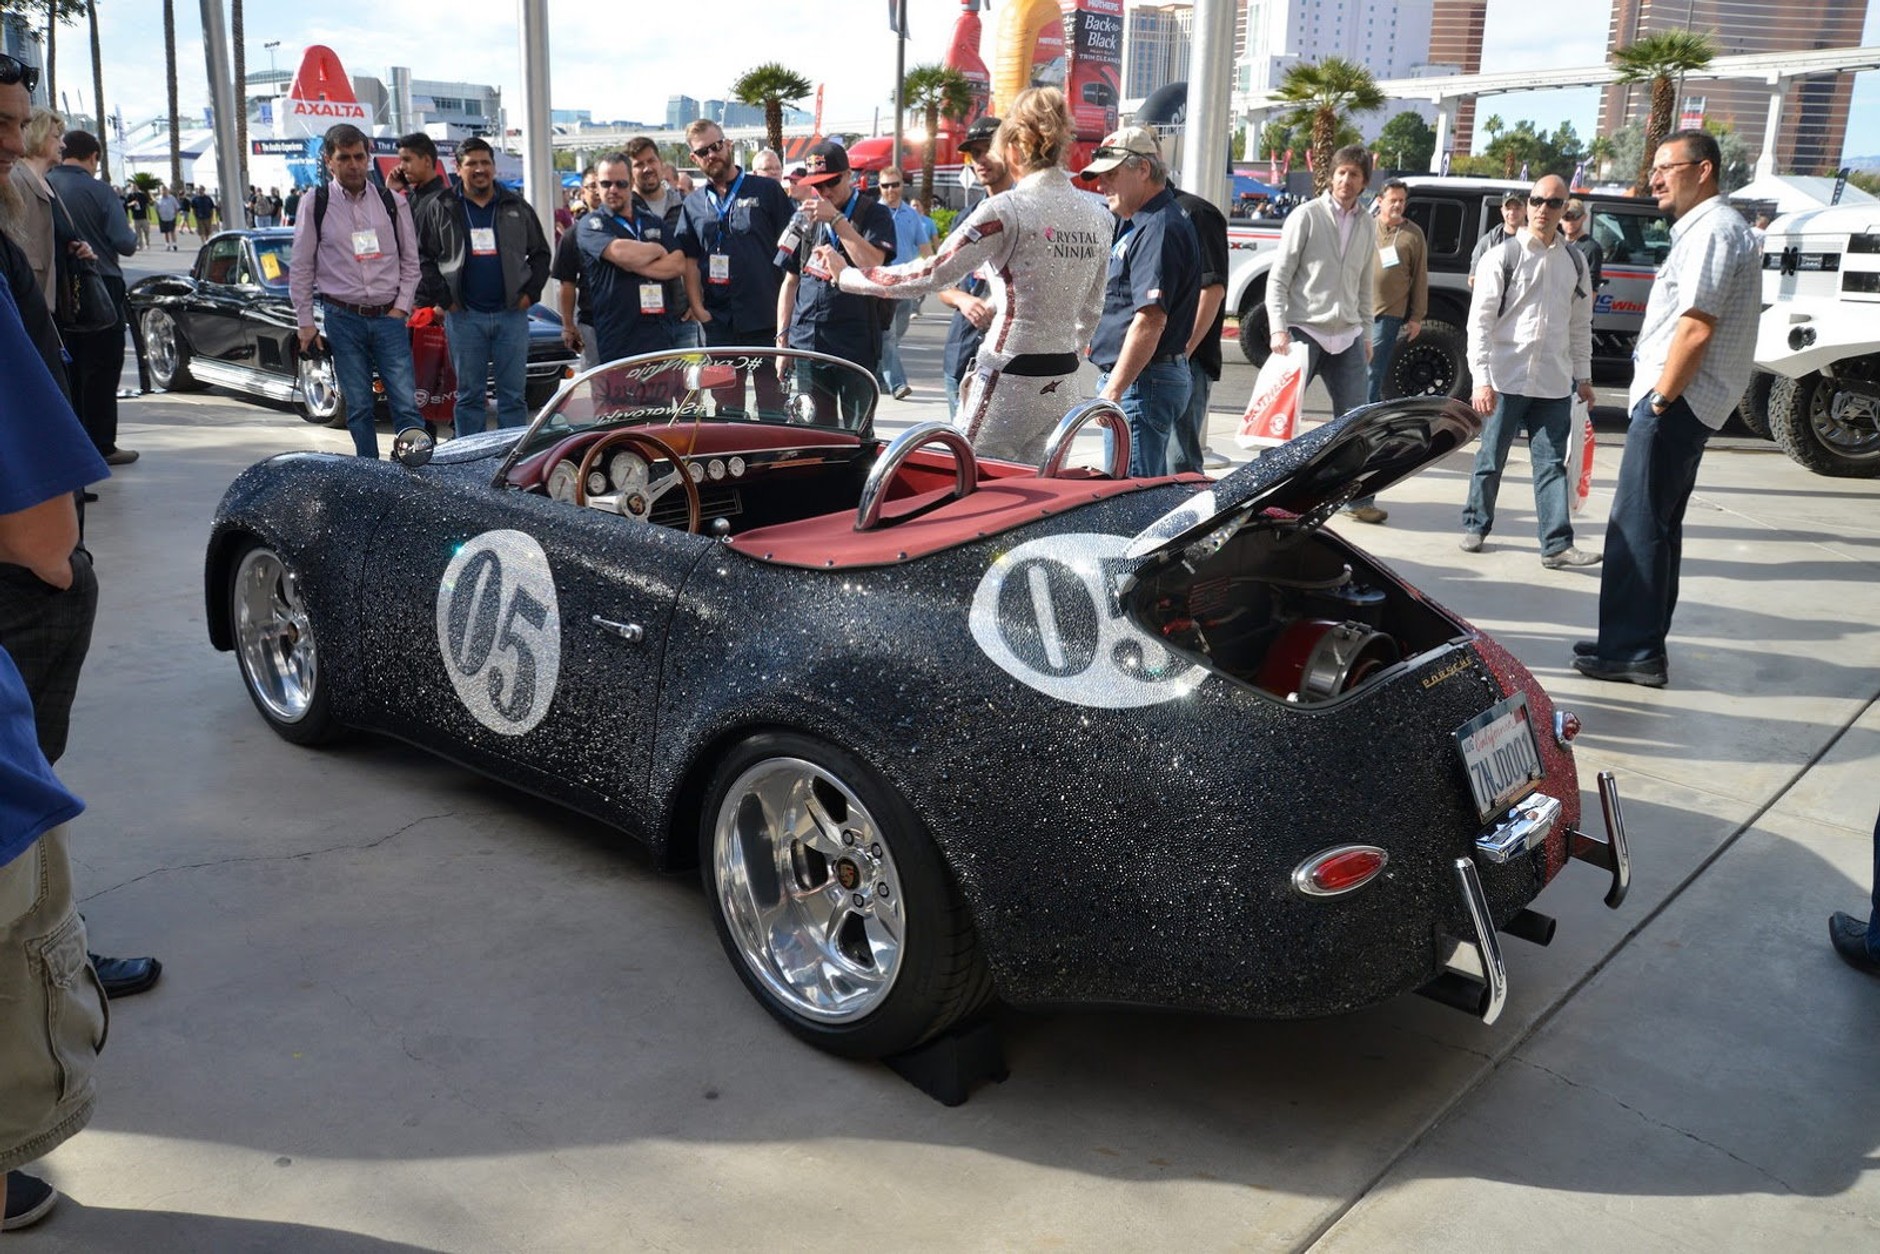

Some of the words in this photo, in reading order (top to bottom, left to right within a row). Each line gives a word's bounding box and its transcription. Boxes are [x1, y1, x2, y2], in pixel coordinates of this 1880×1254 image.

[1087, 32, 1116, 49] Black
[294, 103, 365, 118] AXALTA
[1046, 227, 1100, 243] CRYSTAL
[1053, 244, 1094, 261] NINJA
[448, 548, 549, 723] 05
[1422, 656, 1475, 689] PORSCHE
[1470, 733, 1534, 804] 7NJD001
